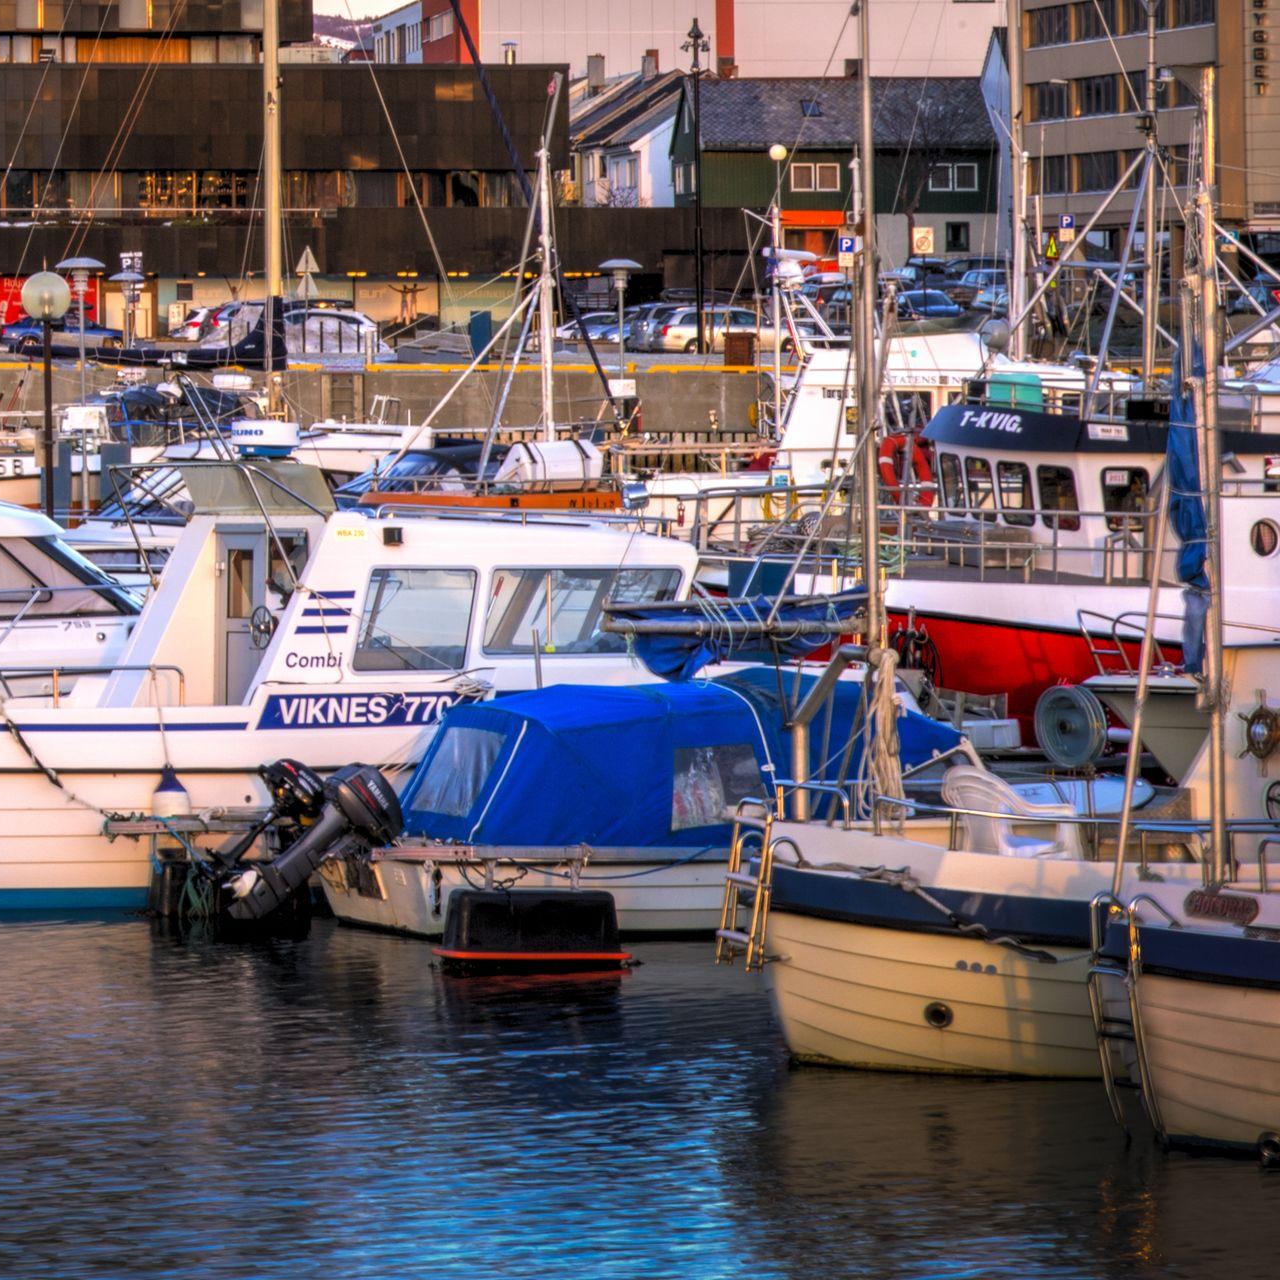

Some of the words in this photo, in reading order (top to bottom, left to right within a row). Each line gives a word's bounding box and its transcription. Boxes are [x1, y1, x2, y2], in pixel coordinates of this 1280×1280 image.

[841, 238, 852, 252] P
[284, 651, 344, 669] Combi
[278, 695, 389, 725] VIKNES
